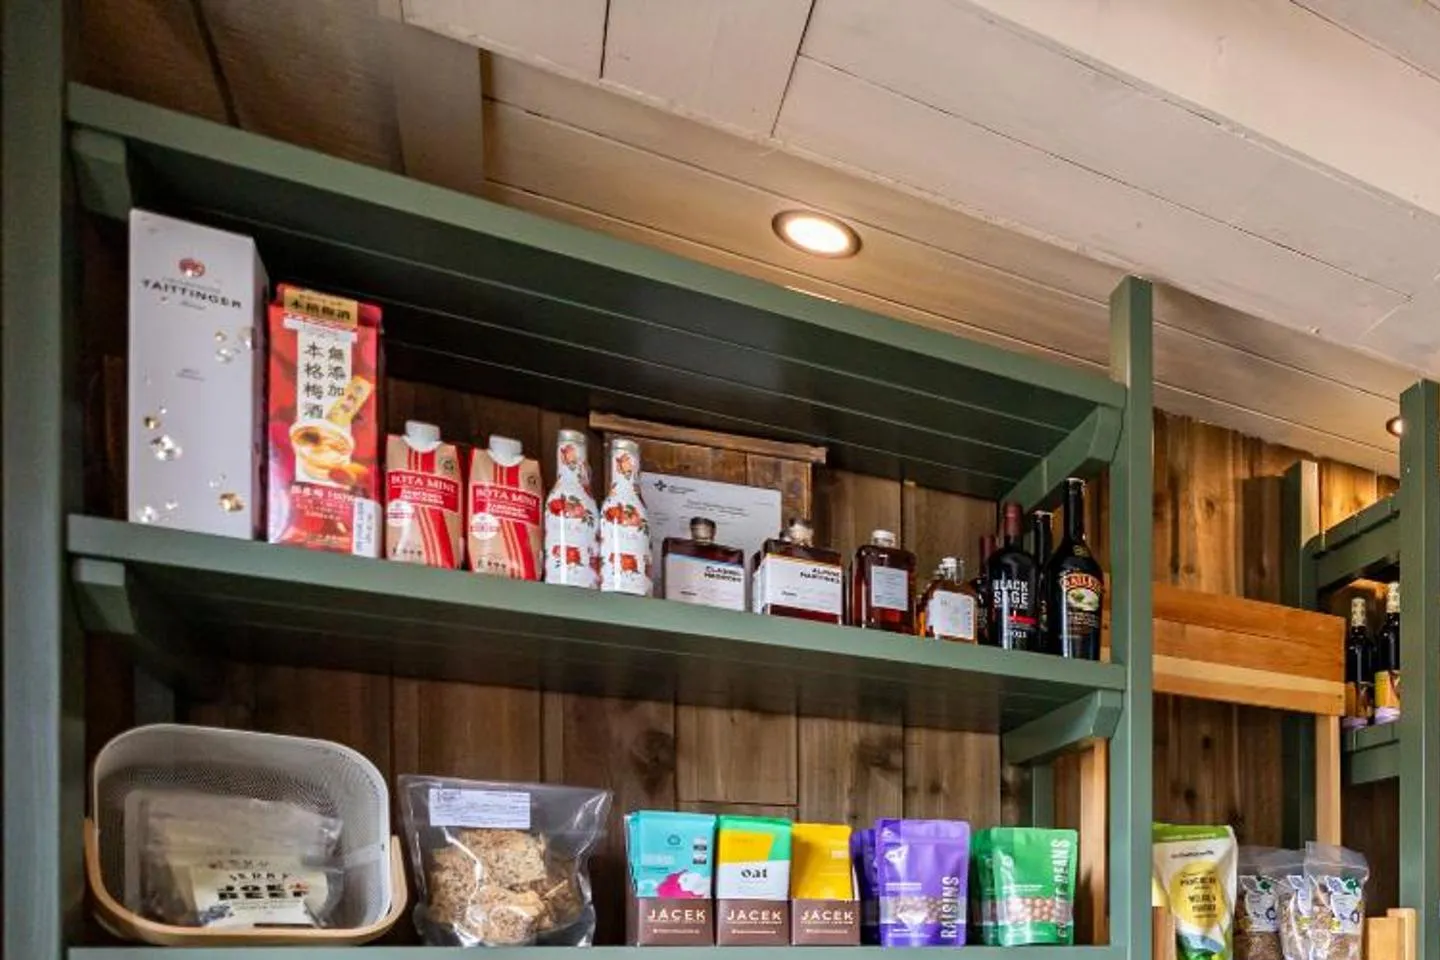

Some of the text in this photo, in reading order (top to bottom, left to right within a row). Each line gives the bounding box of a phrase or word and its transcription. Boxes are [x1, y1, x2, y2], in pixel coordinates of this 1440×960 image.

[142, 279, 242, 308] TAITTINGER
[992, 579, 1028, 592] BLACK
[740, 867, 768, 879] oat
[940, 876, 960, 939] RAISINS
[647, 908, 706, 922] JACEK
[727, 909, 782, 921] JACEK
[801, 909, 854, 921] JACEK
